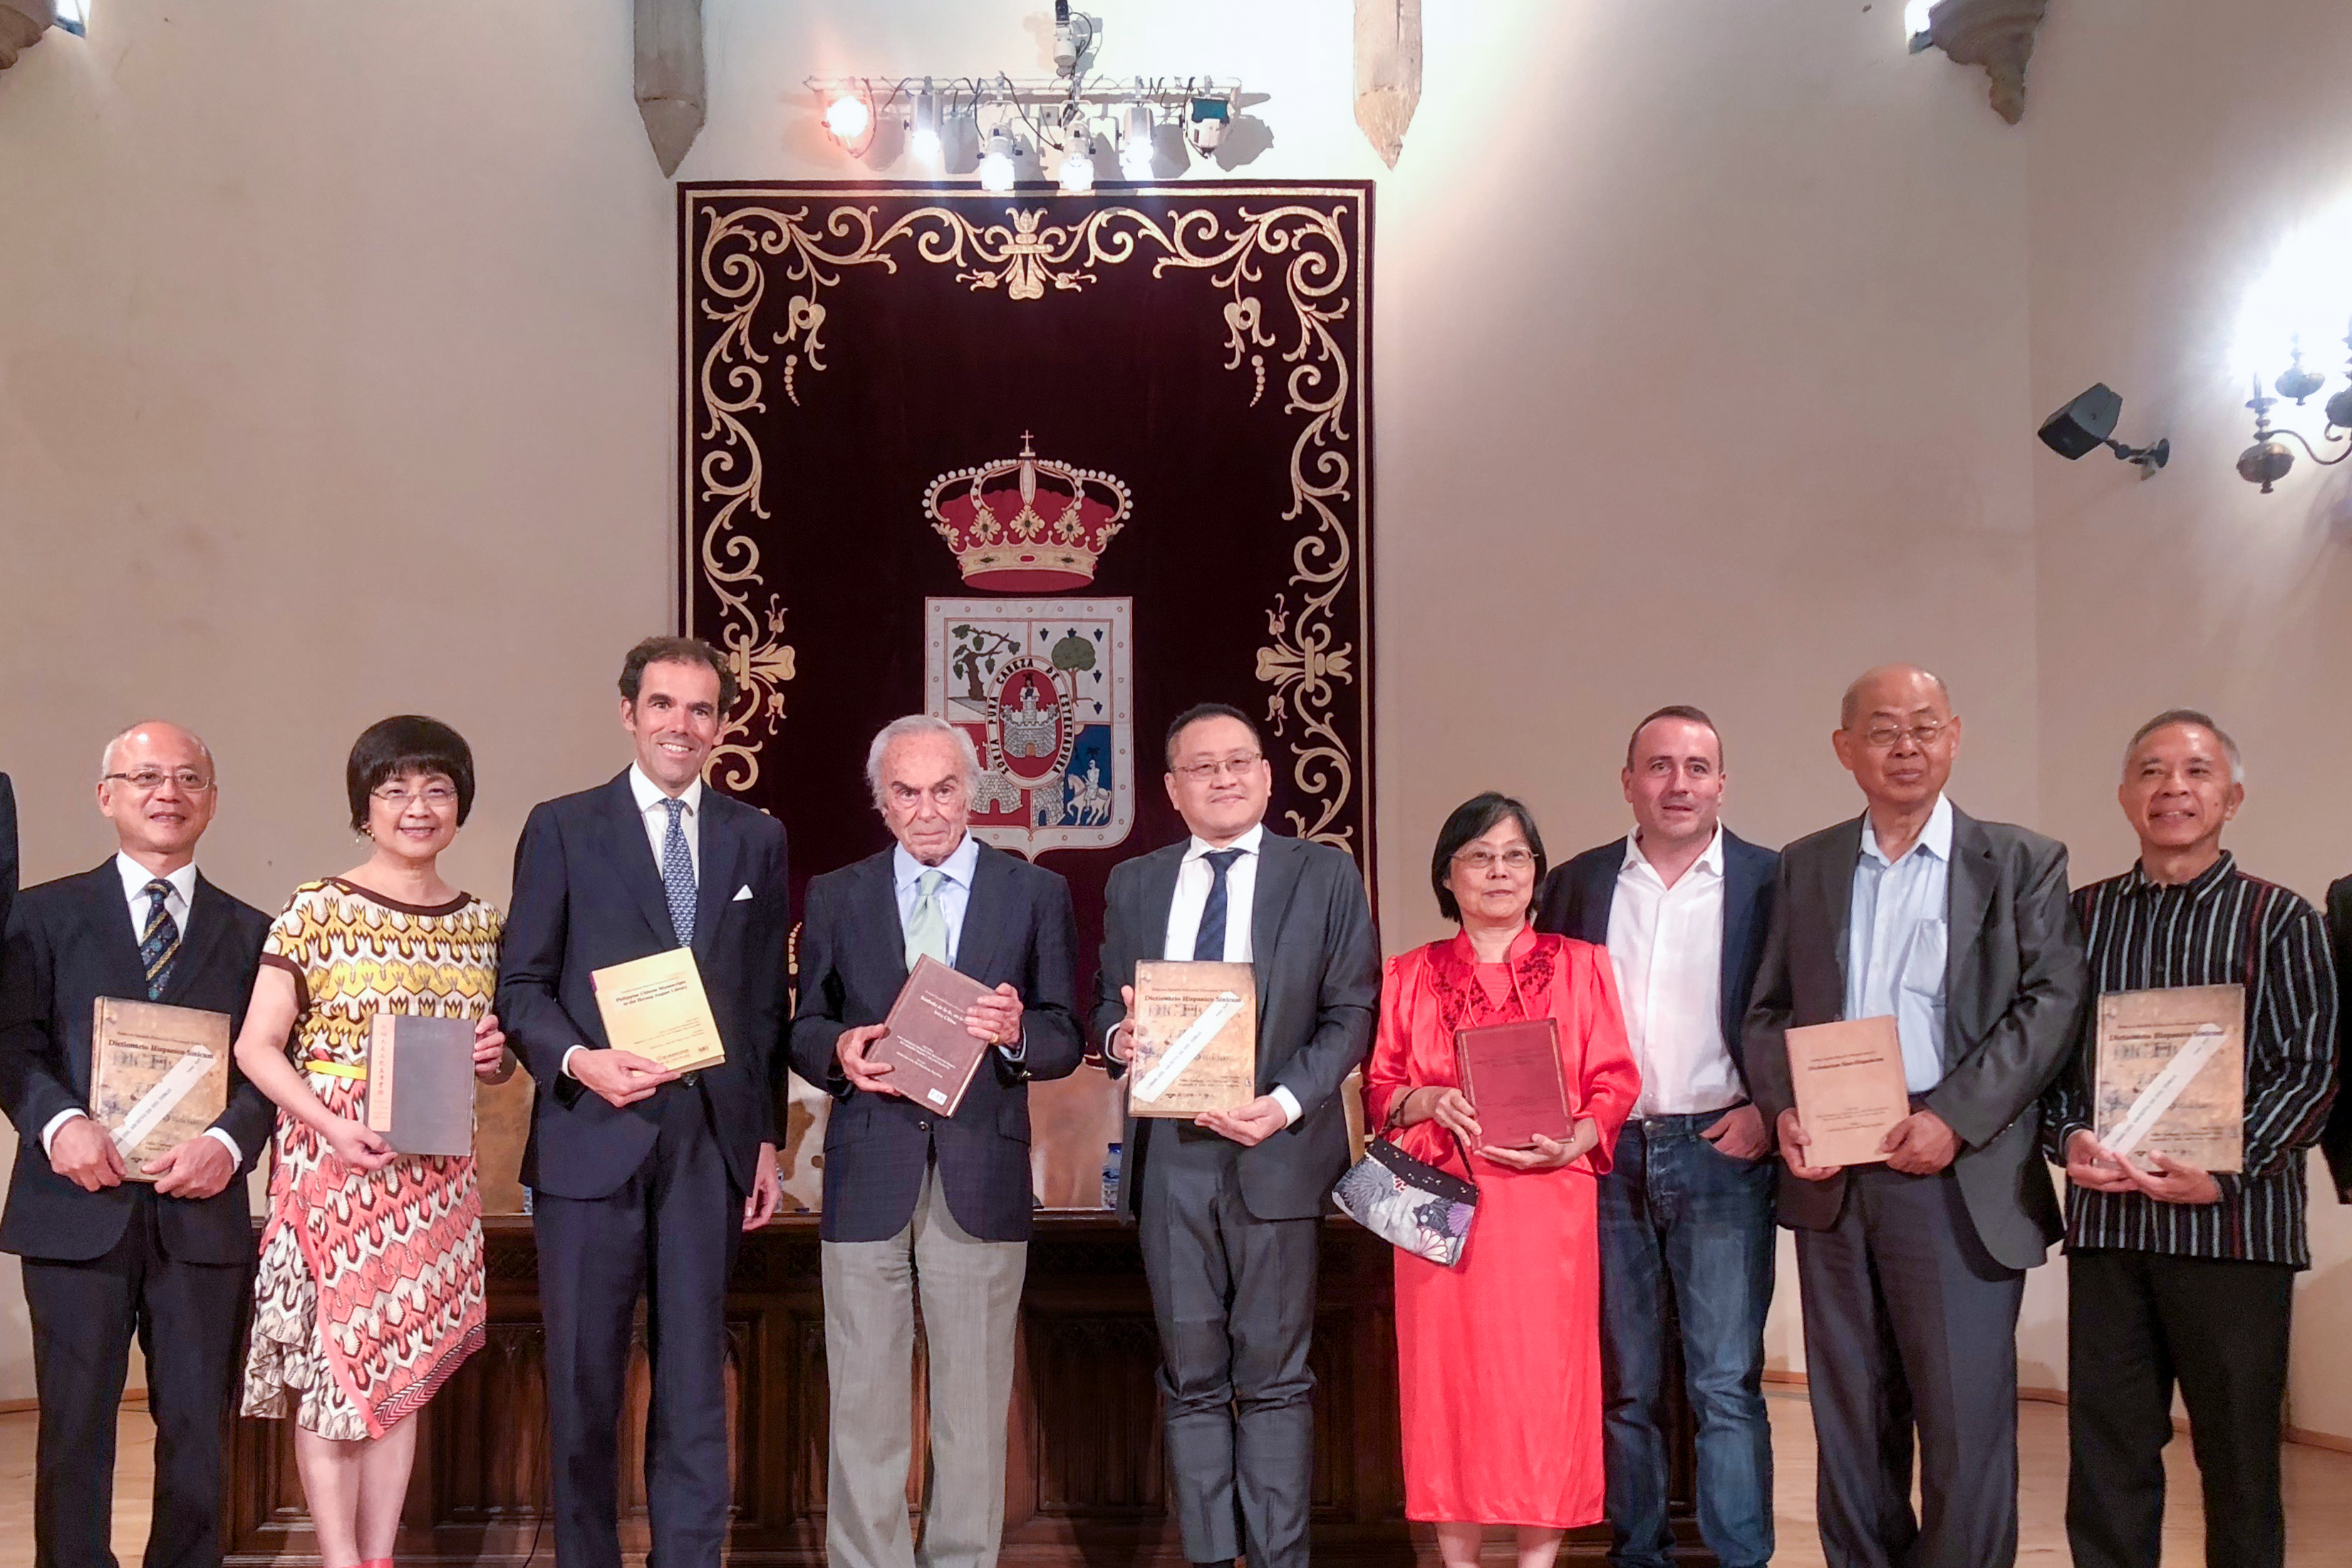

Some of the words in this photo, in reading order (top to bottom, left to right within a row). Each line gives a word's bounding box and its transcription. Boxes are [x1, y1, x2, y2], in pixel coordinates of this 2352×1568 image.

[996, 658, 1033, 685] CABEZA
[1046, 666, 1060, 681] DE
[988, 697, 999, 725] PURA
[1052, 693, 1073, 774] ESTREMADURA
[990, 739, 1010, 775] SORIA
[108, 1039, 149, 1051] Dictionario
[150, 1044, 185, 1055] Hispanico
